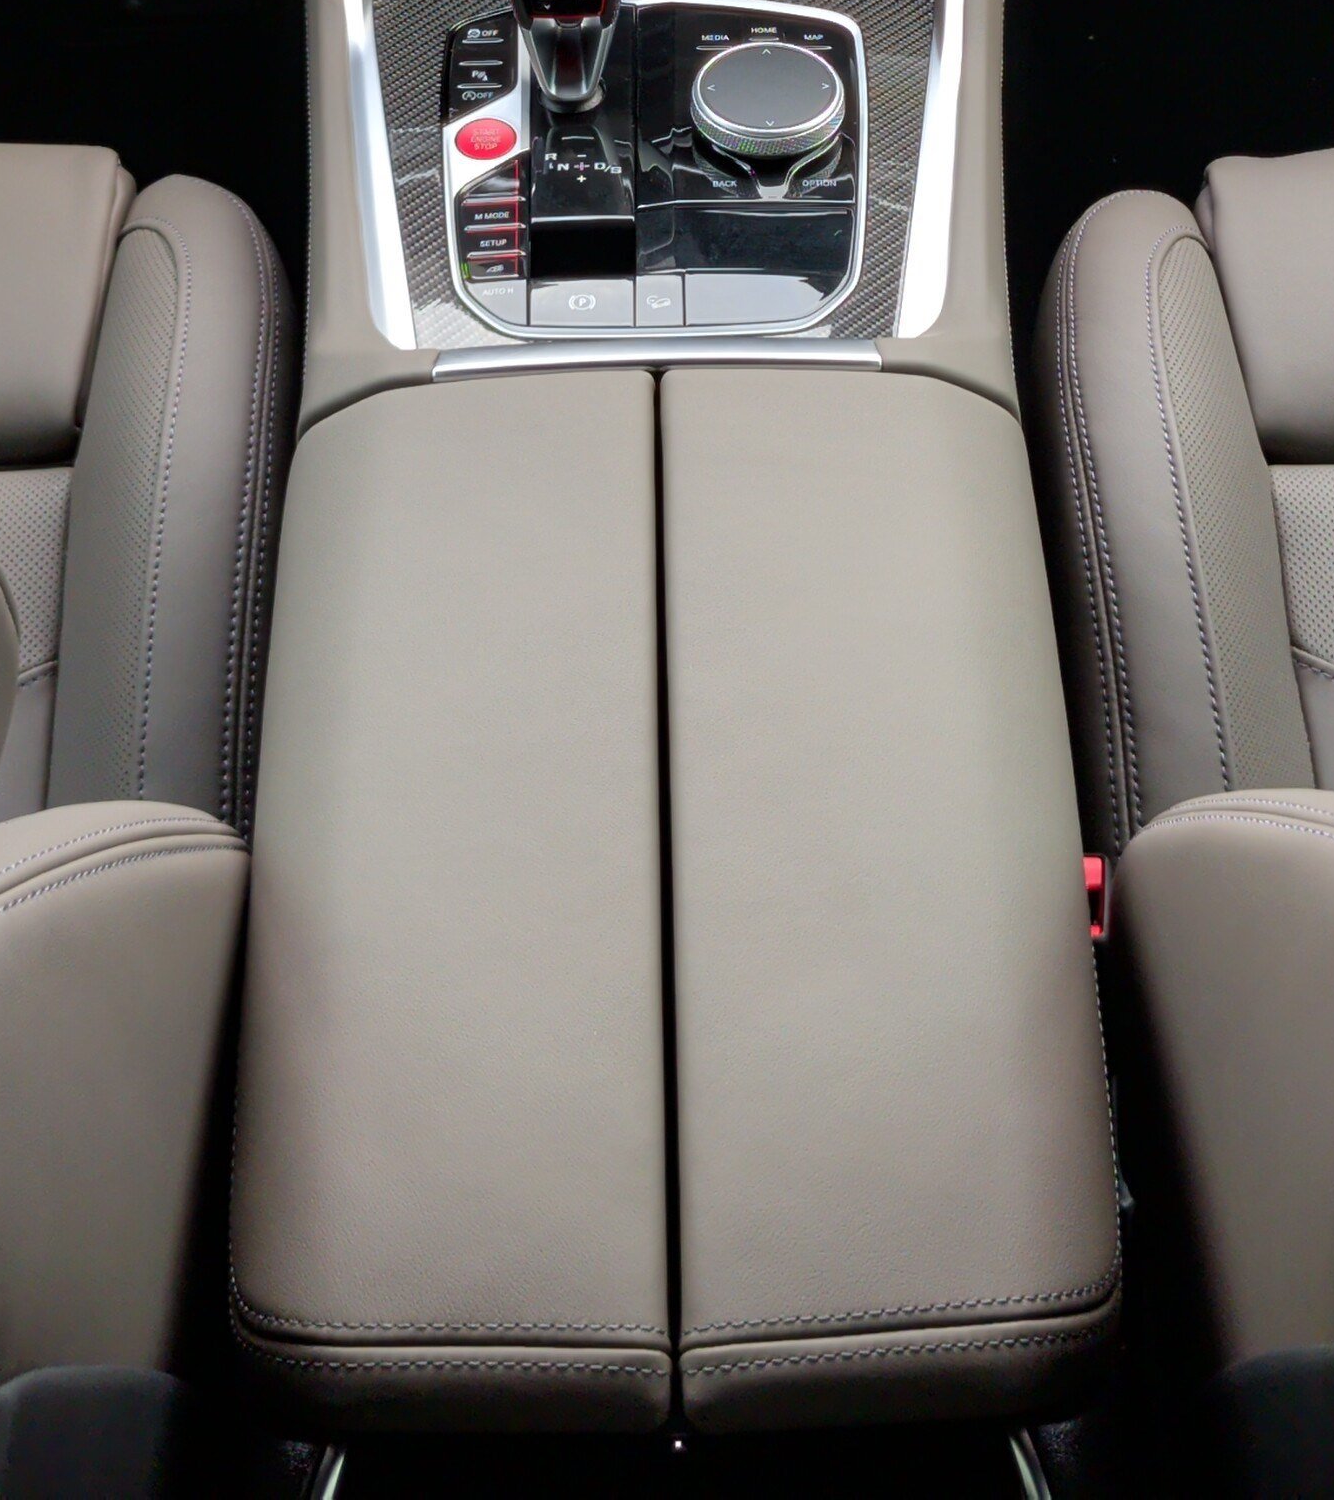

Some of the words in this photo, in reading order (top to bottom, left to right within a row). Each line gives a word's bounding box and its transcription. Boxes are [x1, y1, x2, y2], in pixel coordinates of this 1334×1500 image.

[481, 29, 499, 37] OFF
[751, 26, 777, 34] HOME
[701, 34, 730, 42] MEDIA
[473, 128, 499, 136] START
[471, 136, 501, 144] ENGINE
[545, 152, 557, 160] R
[557, 163, 569, 171] N
[712, 180, 738, 188] BACK
[802, 180, 837, 188] OPTION
[484, 211, 509, 220] MODE
[479, 238, 507, 248] SETUP
[482, 288, 505, 296] AUTO
